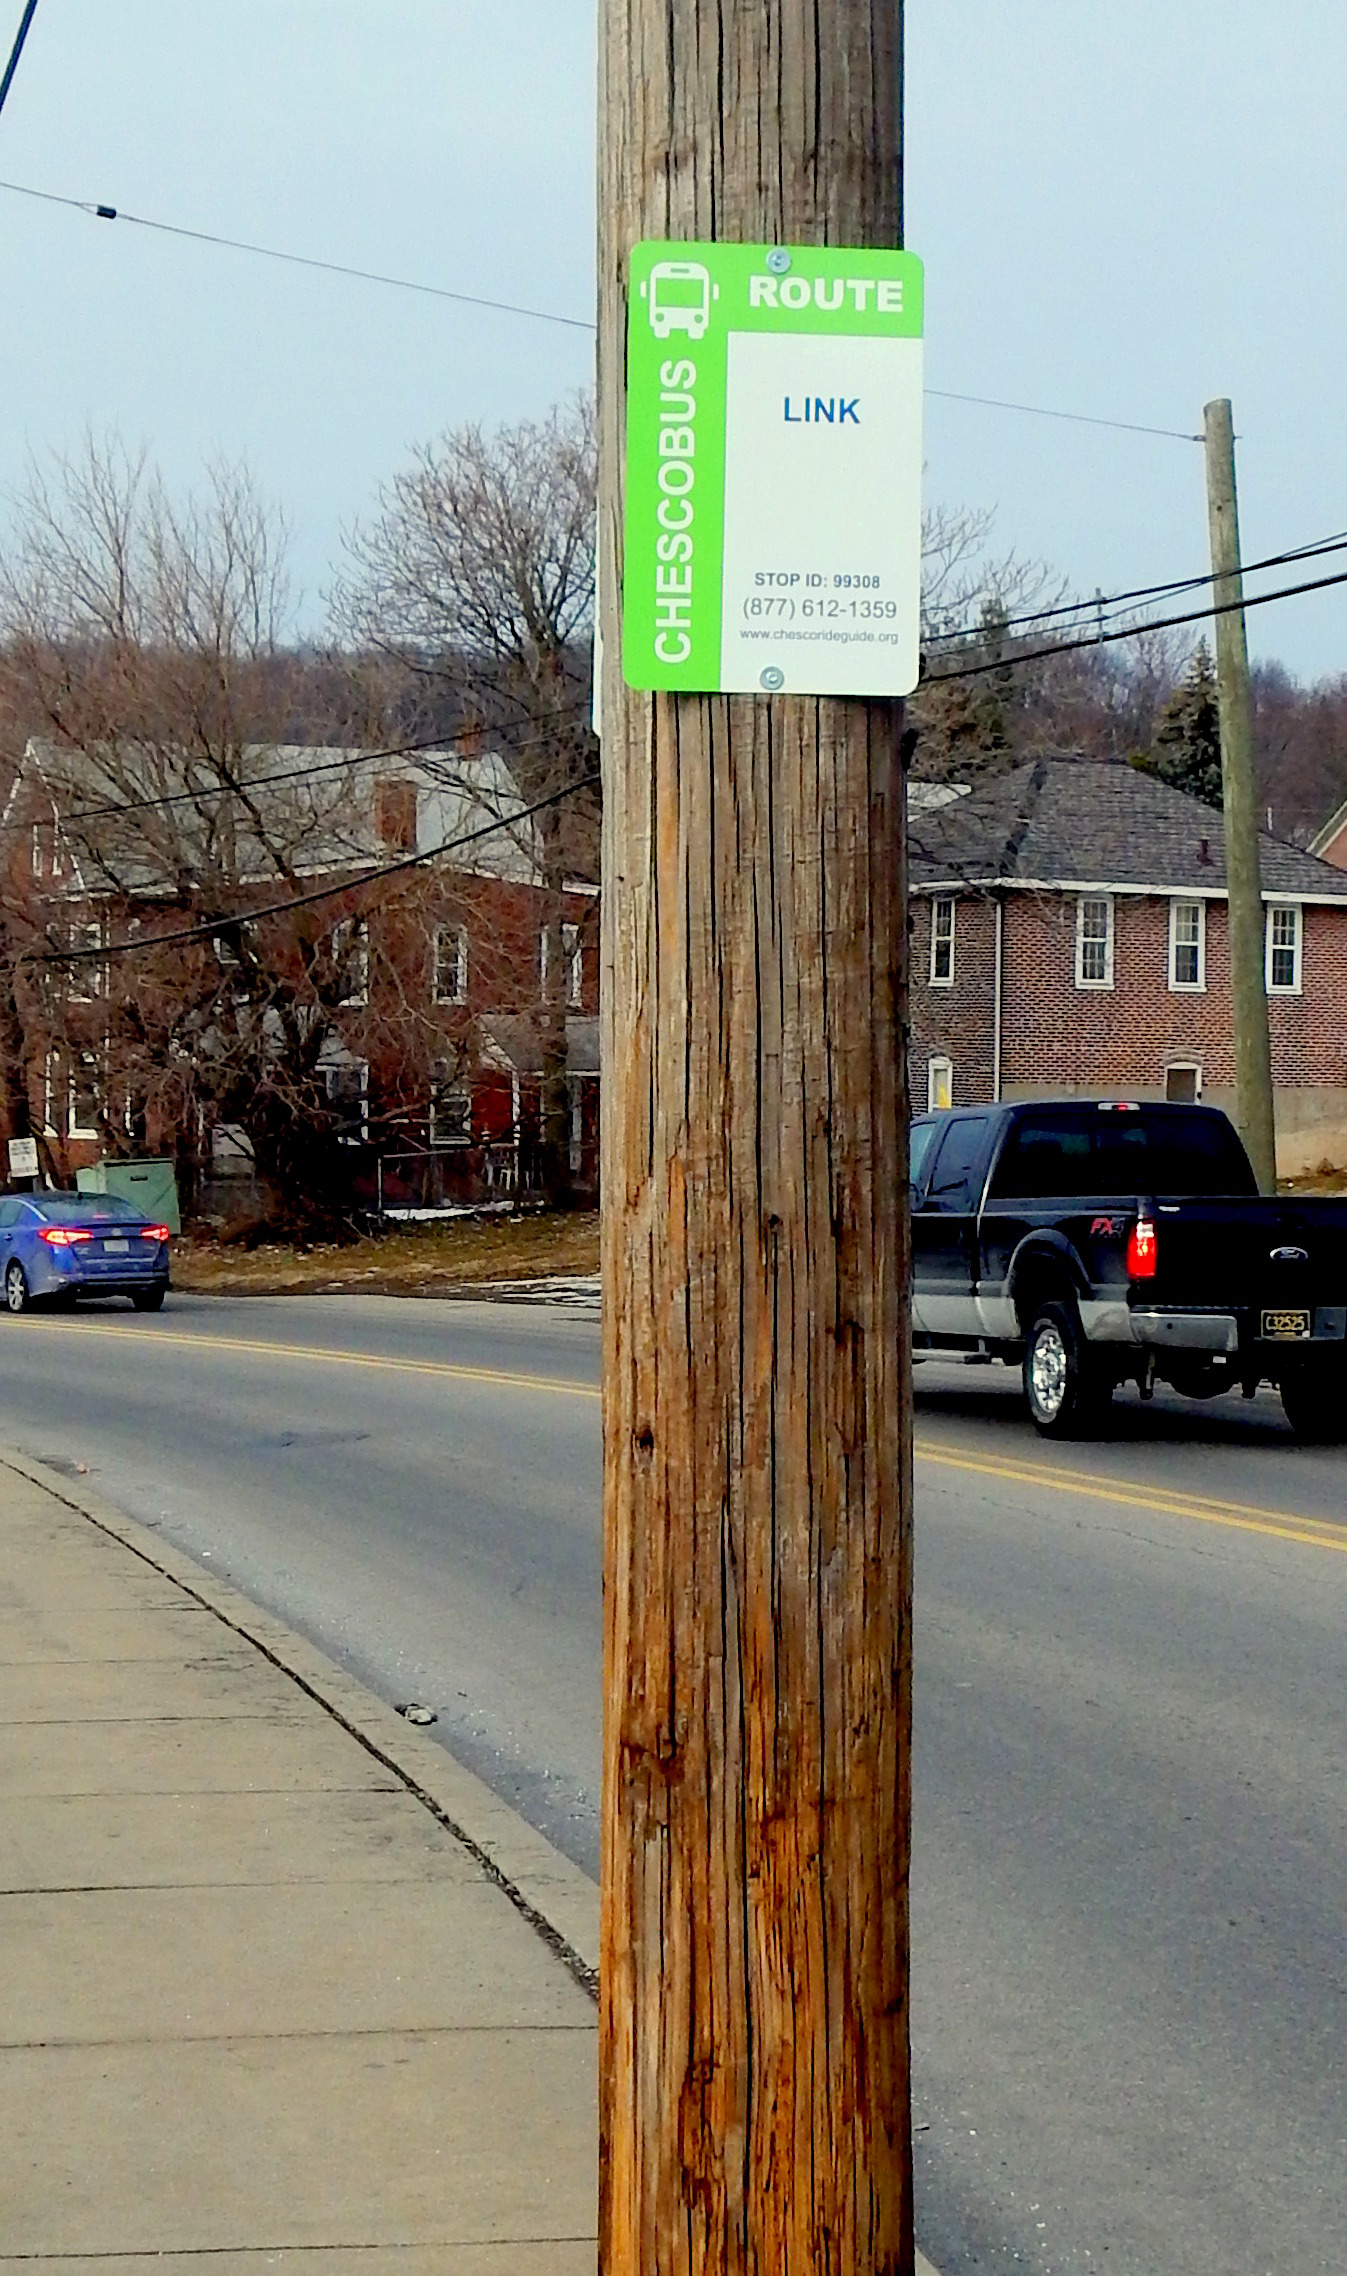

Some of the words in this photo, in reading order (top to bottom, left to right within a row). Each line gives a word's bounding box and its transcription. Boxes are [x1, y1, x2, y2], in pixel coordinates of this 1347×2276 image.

[749, 275, 904, 312] ROUTE
[784, 396, 861, 424] LINK
[654, 359, 697, 664] CHESCOBUS
[754, 572, 801, 587] STOP
[805, 573, 828, 588] ID:
[833, 574, 880, 589] 99308
[743, 597, 796, 620] (877)
[801, 598, 898, 619] 612-1359
[740, 629, 899, 645] www.chescorideguide.org
